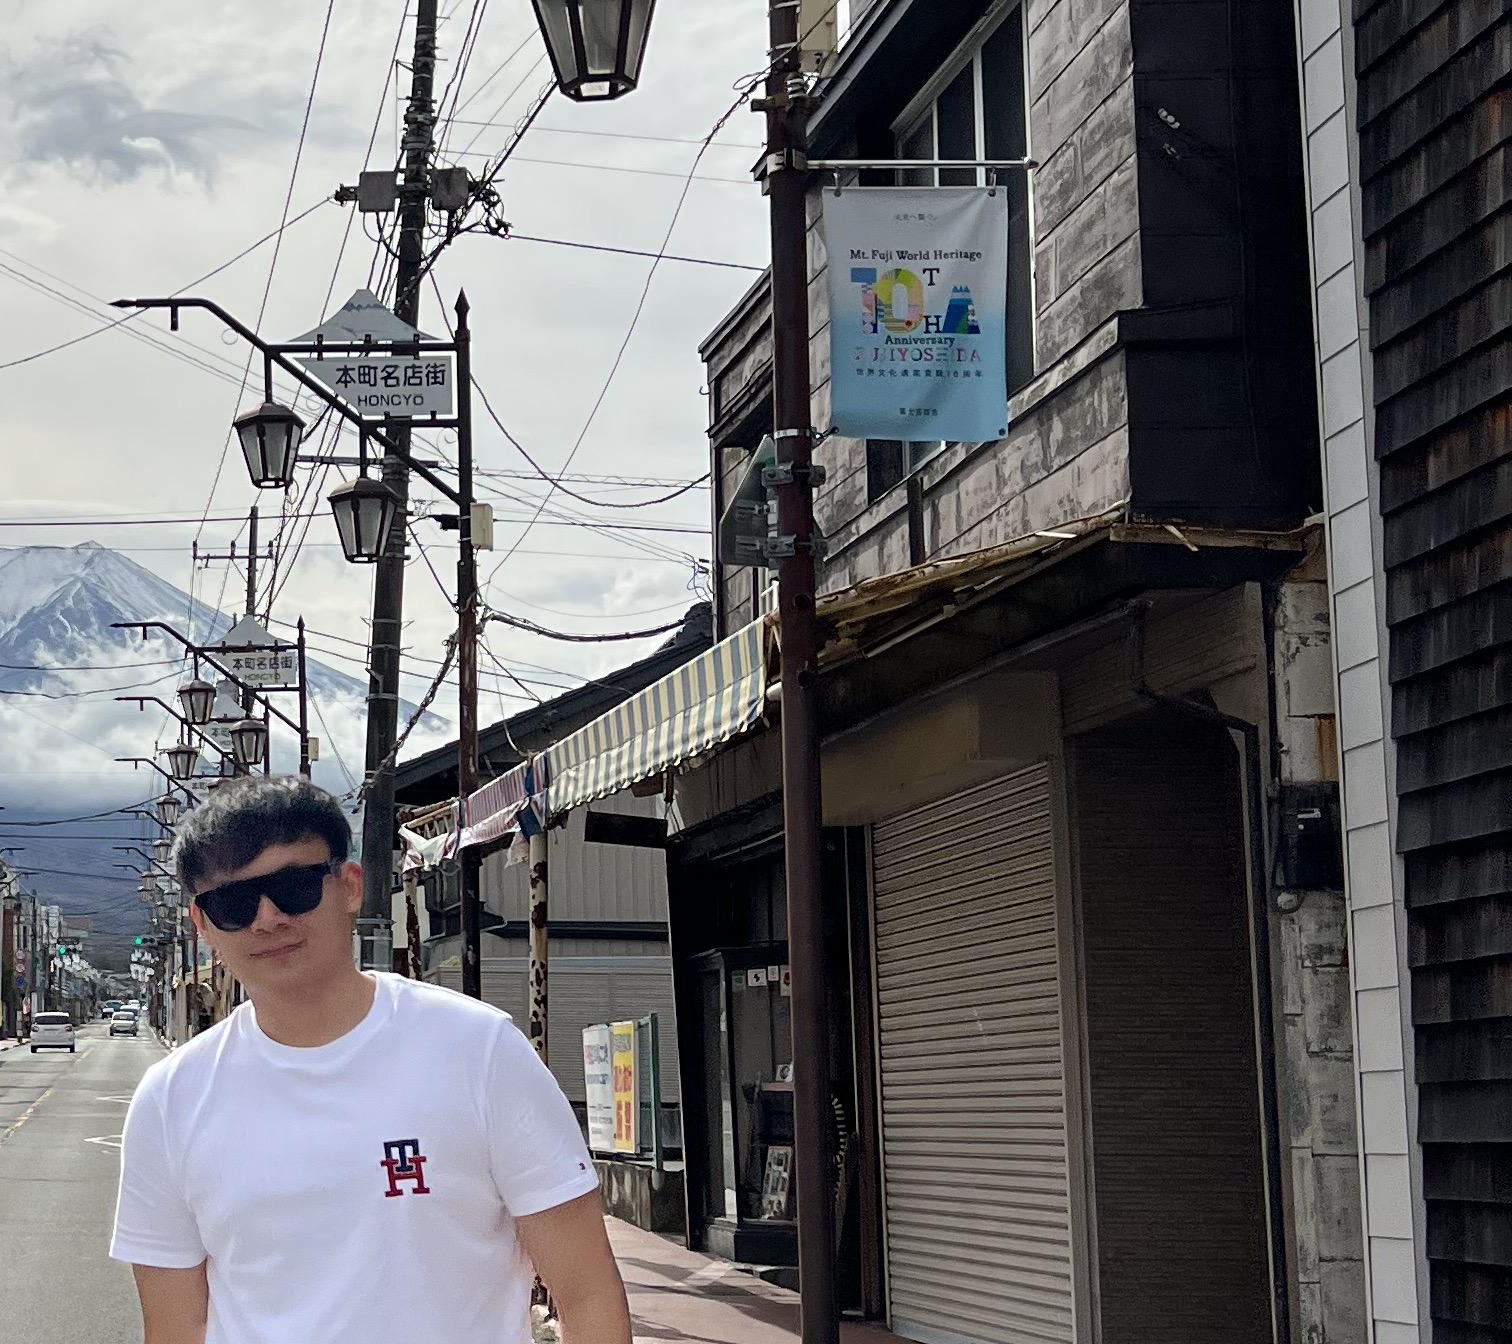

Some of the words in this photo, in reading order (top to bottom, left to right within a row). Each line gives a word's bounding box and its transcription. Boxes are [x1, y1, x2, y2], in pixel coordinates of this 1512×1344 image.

[871, 249, 893, 263] Fuji
[896, 250, 930, 261] World
[933, 249, 982, 262] Heritage
[885, 335, 956, 349] Anniversary
[335, 363, 446, 389] 本町名店街
[358, 393, 424, 407] HONCYO
[232, 656, 294, 671] 本町名店街
